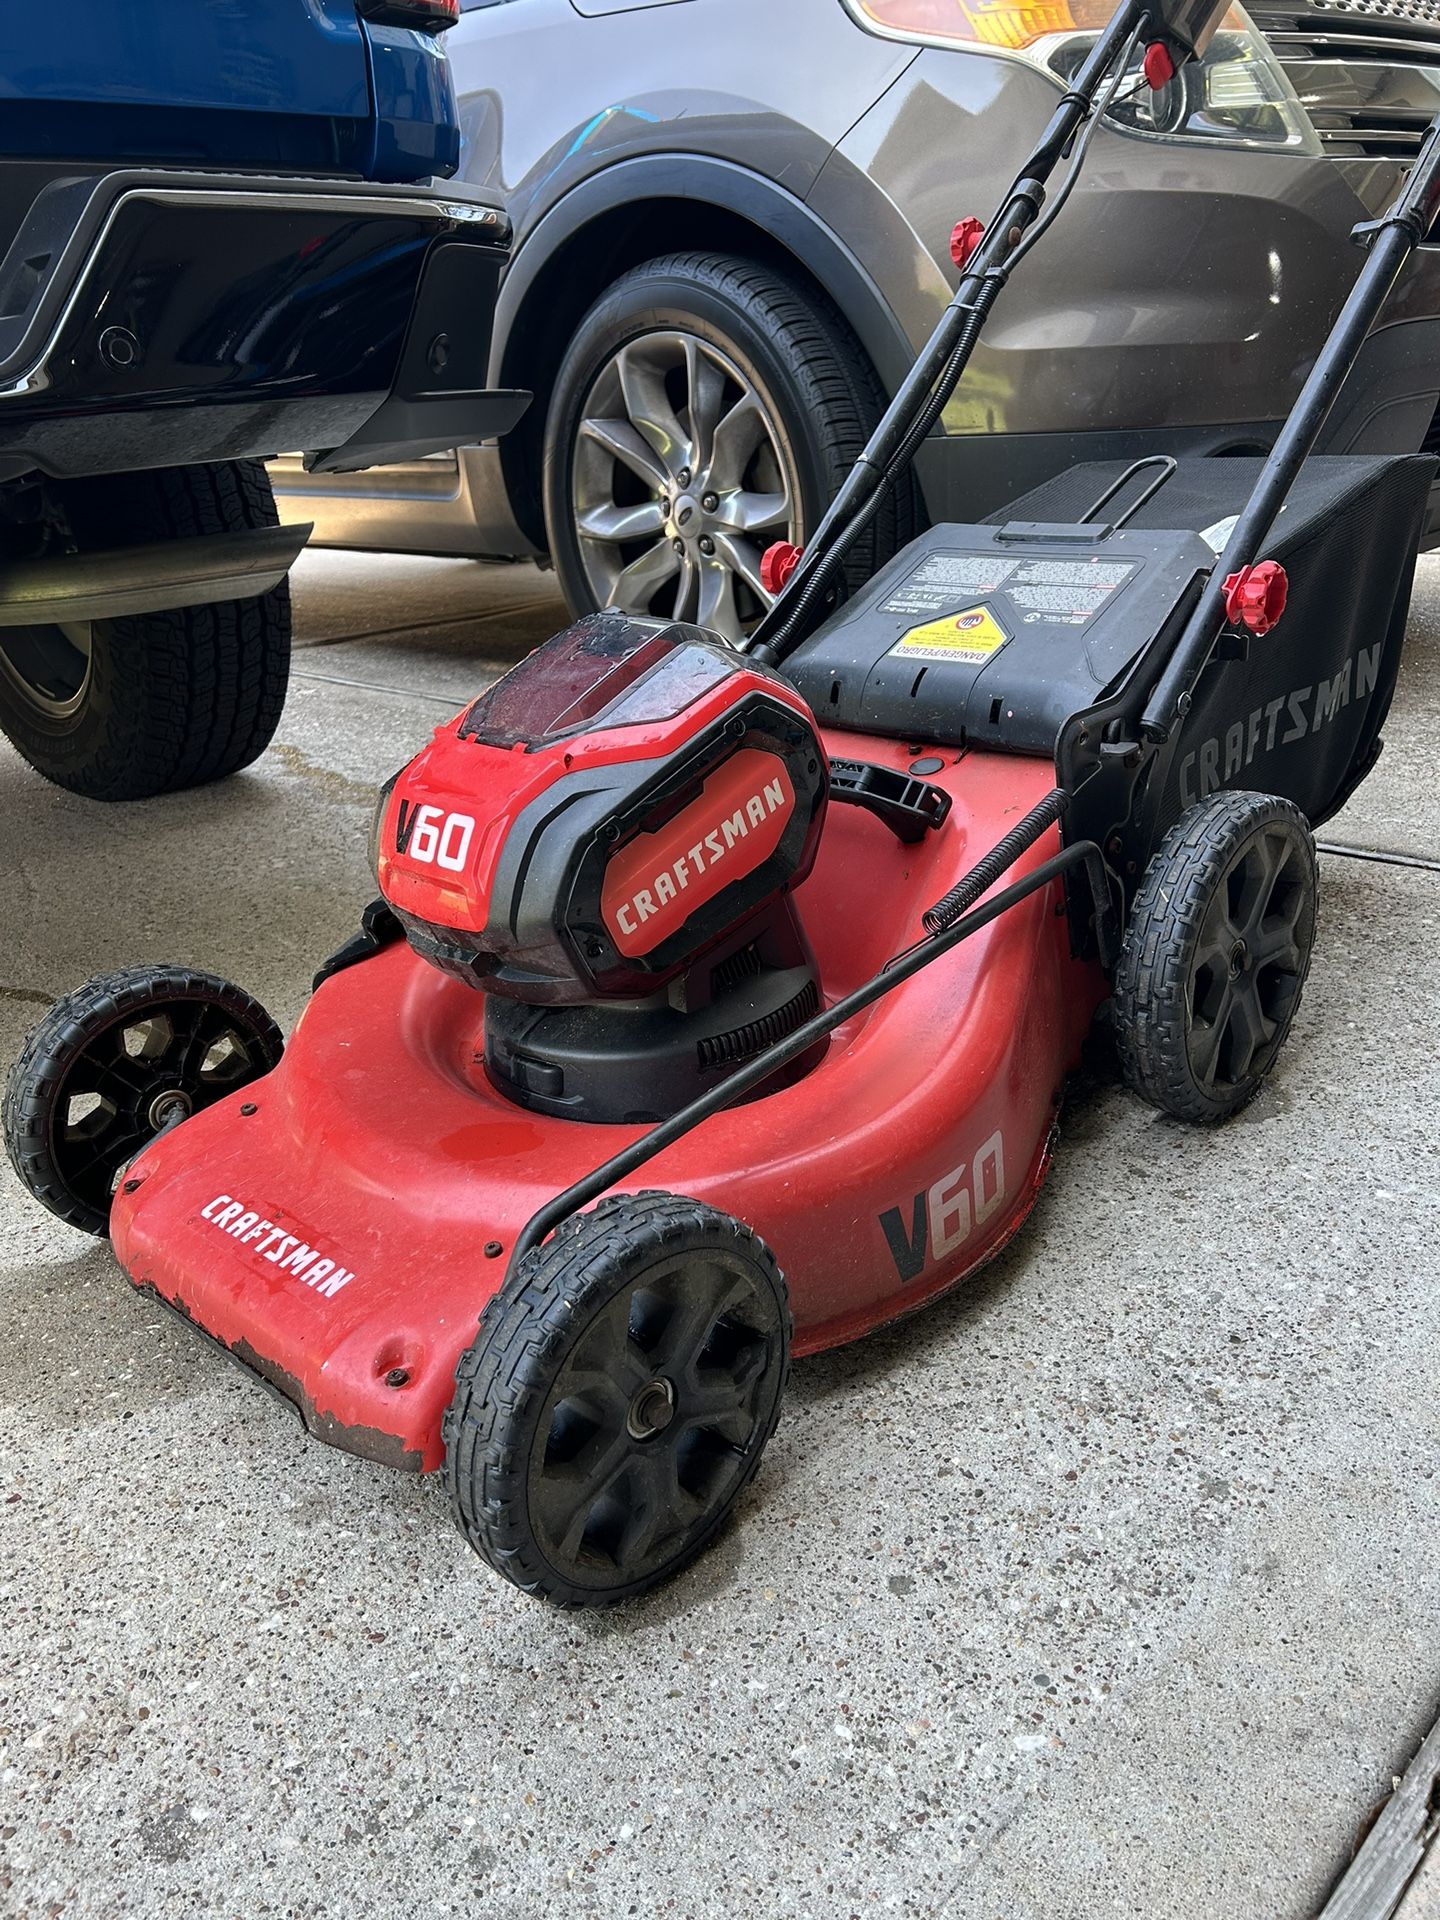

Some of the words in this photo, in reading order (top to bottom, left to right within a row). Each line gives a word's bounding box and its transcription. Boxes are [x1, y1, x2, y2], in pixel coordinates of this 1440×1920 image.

[897, 645, 985, 660] DANGER/PELIGRO
[1179, 642, 1381, 810] CRAFTSMAN
[396, 799, 475, 872] V60
[616, 777, 785, 935] CRAFTSMAN
[201, 1195, 355, 1298] CRAFTSMAN
[878, 1130, 1005, 1283] V60
